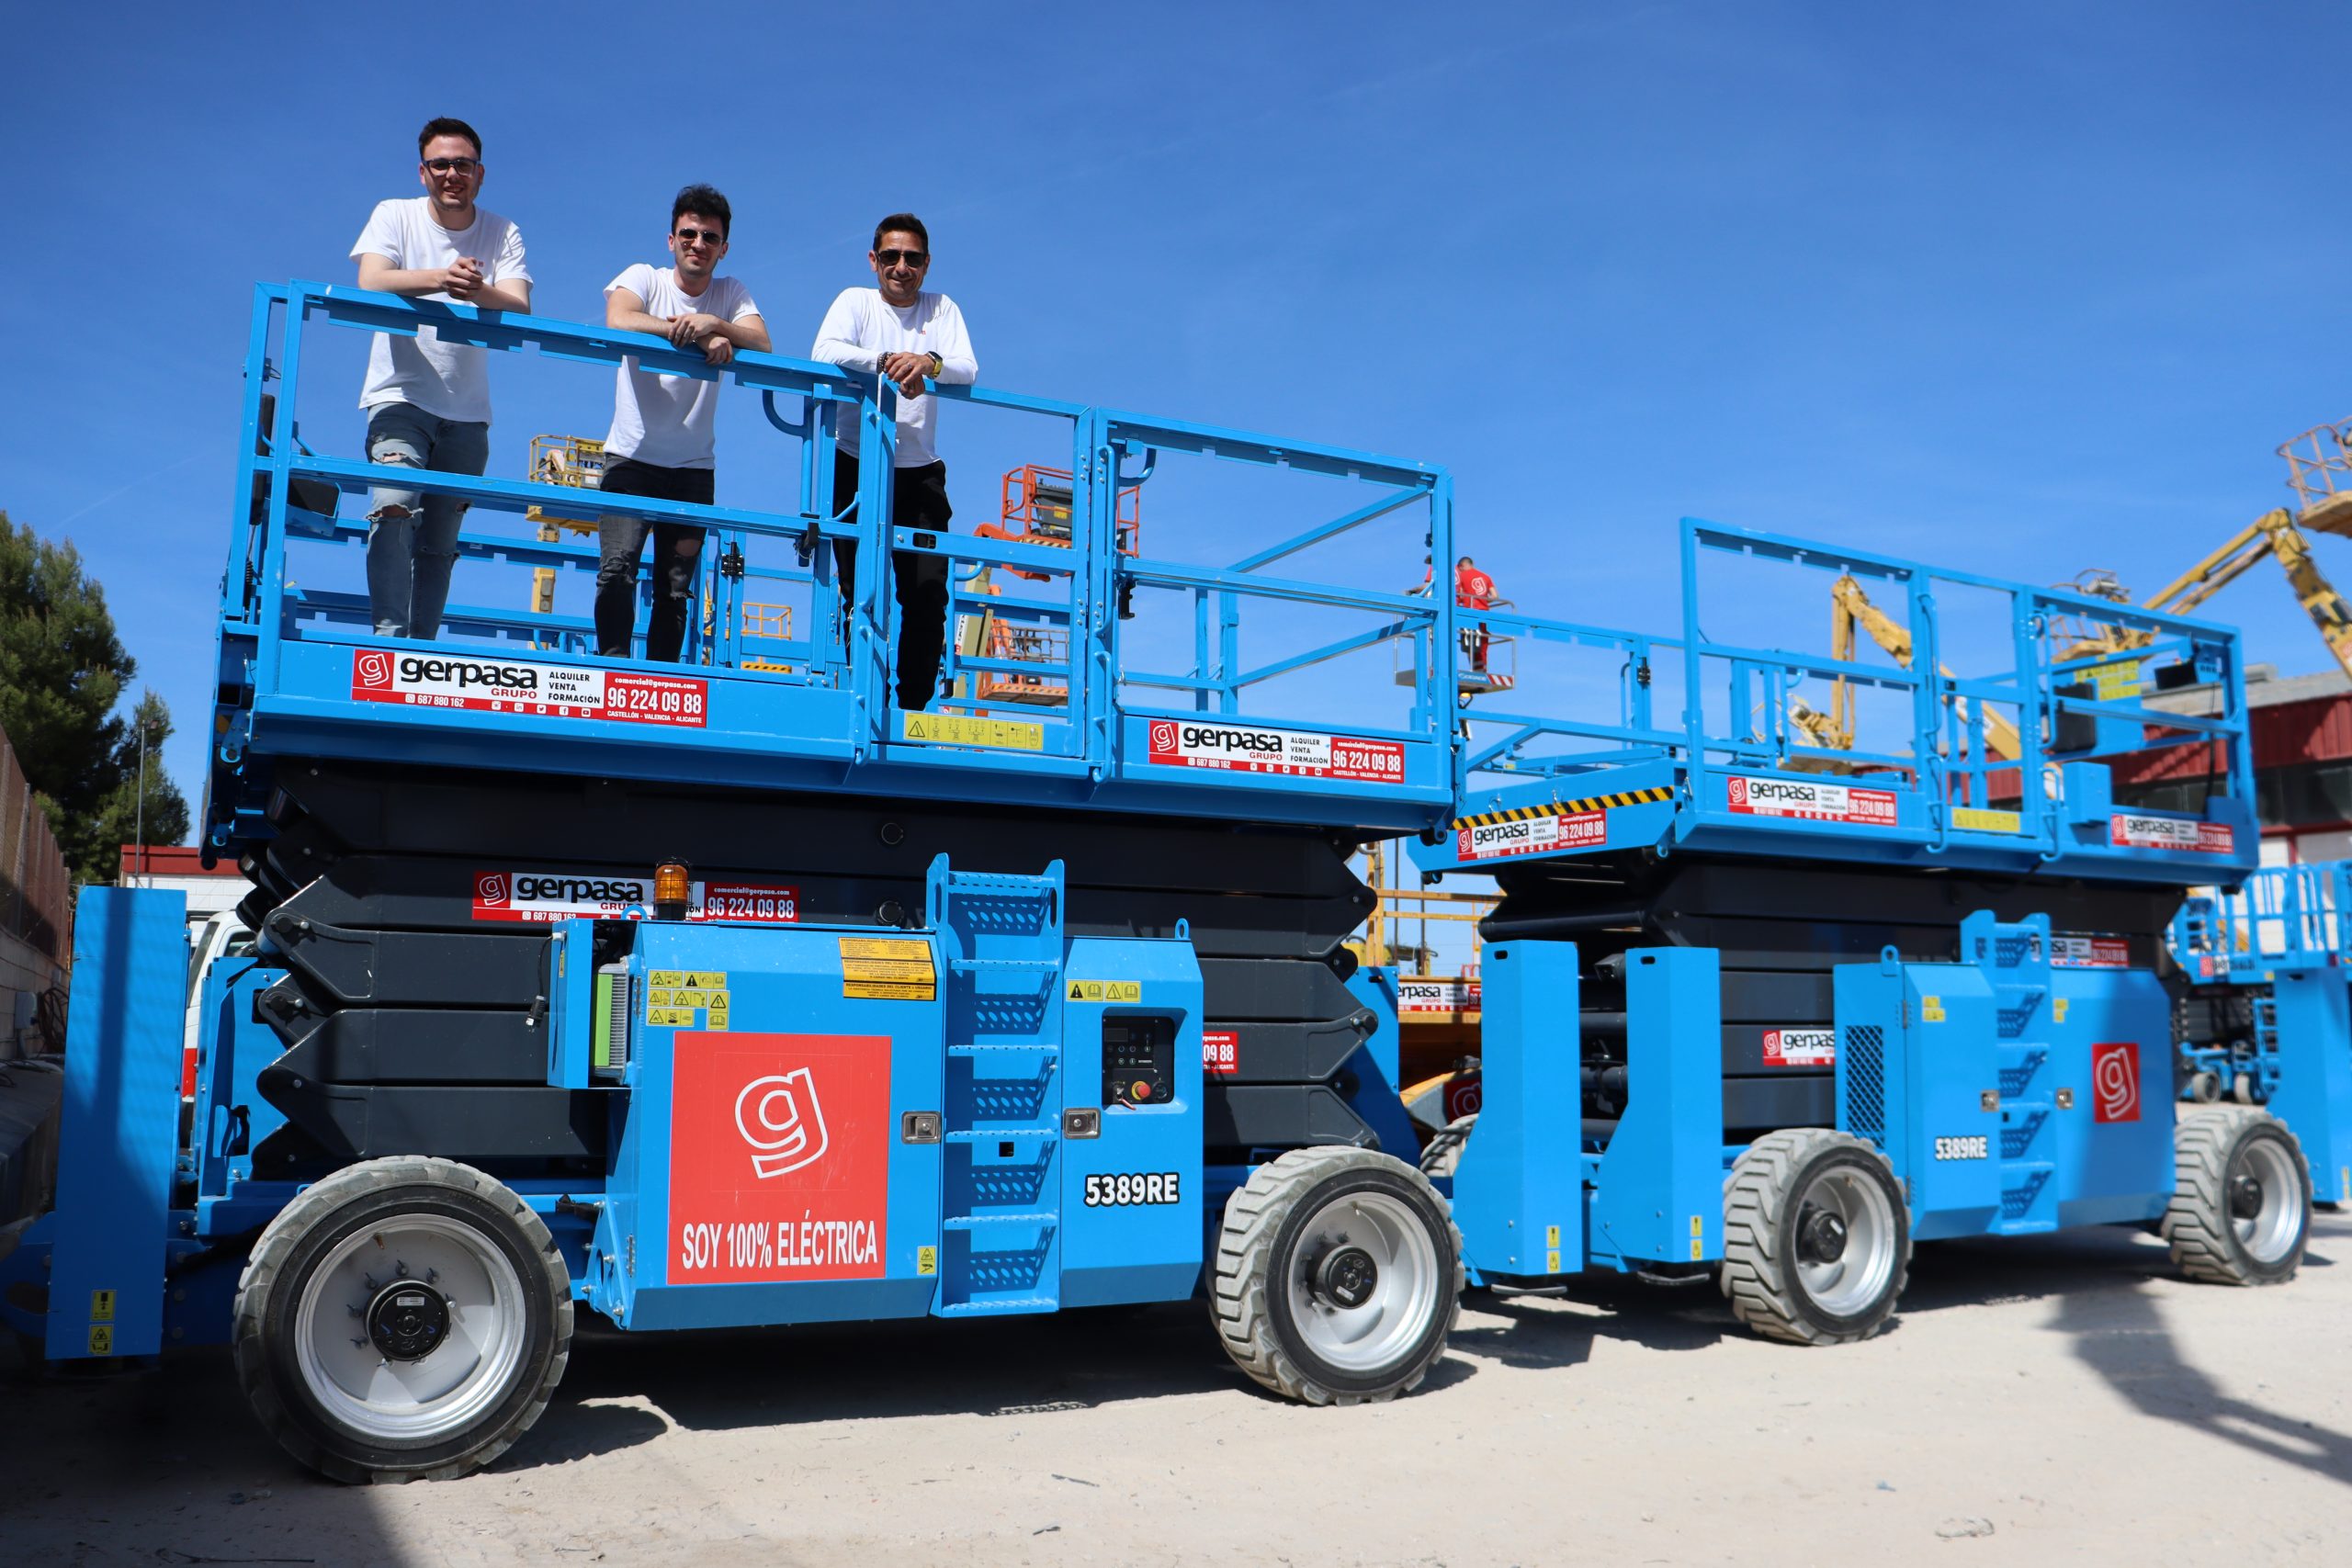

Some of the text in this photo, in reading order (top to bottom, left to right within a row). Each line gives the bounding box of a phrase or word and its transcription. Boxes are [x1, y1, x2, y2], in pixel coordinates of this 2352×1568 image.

[400, 658, 538, 690] gerpasa
[548, 671, 591, 682] ALQUILER
[548, 682, 577, 692] VENTA
[615, 677, 697, 690] comercial@gerpasa.com
[417, 694, 465, 707] 687 880 162
[491, 687, 537, 699] GRUPO
[548, 692, 601, 705] FORMACIÓN
[607, 687, 702, 714] 96 224 09 88
[607, 710, 639, 718] CASTELLÓN
[644, 713, 671, 721] VALENCIA
[1182, 727, 1283, 752] gerpasa
[1290, 737, 1320, 746] ALQUILER
[1249, 751, 1283, 761] GRUPO
[1290, 746, 1311, 754] VENTA
[1290, 755, 1329, 764] FORMACIÓN
[1332, 750, 1401, 773] 96 224 09 88
[1749, 782, 1815, 802] gerpasa
[1474, 822, 1530, 845] gerpasa
[1559, 825, 1568, 840] 96
[1569, 823, 1583, 839] 224
[1510, 837, 1530, 845] GRUPO
[516, 876, 645, 903] gerpasa
[714, 886, 790, 897] comercial@gerpasa.com
[707, 897, 725, 917] 96
[728, 897, 754, 918] 224
[757, 898, 775, 918] 09
[777, 899, 795, 919] 88
[533, 912, 547, 920] 687
[548, 912, 562, 921] 880
[1397, 985, 1441, 999] erpasa
[1783, 1033, 1835, 1050] gerpas
[1204, 1043, 1235, 1062] 09 88
[735, 1066, 828, 1179] g
[1935, 1136, 1987, 1160] 5389RE
[1085, 1173, 1179, 1206] 5389RE
[682, 1209, 878, 1269] SOY 100% ELÉCTRICA
